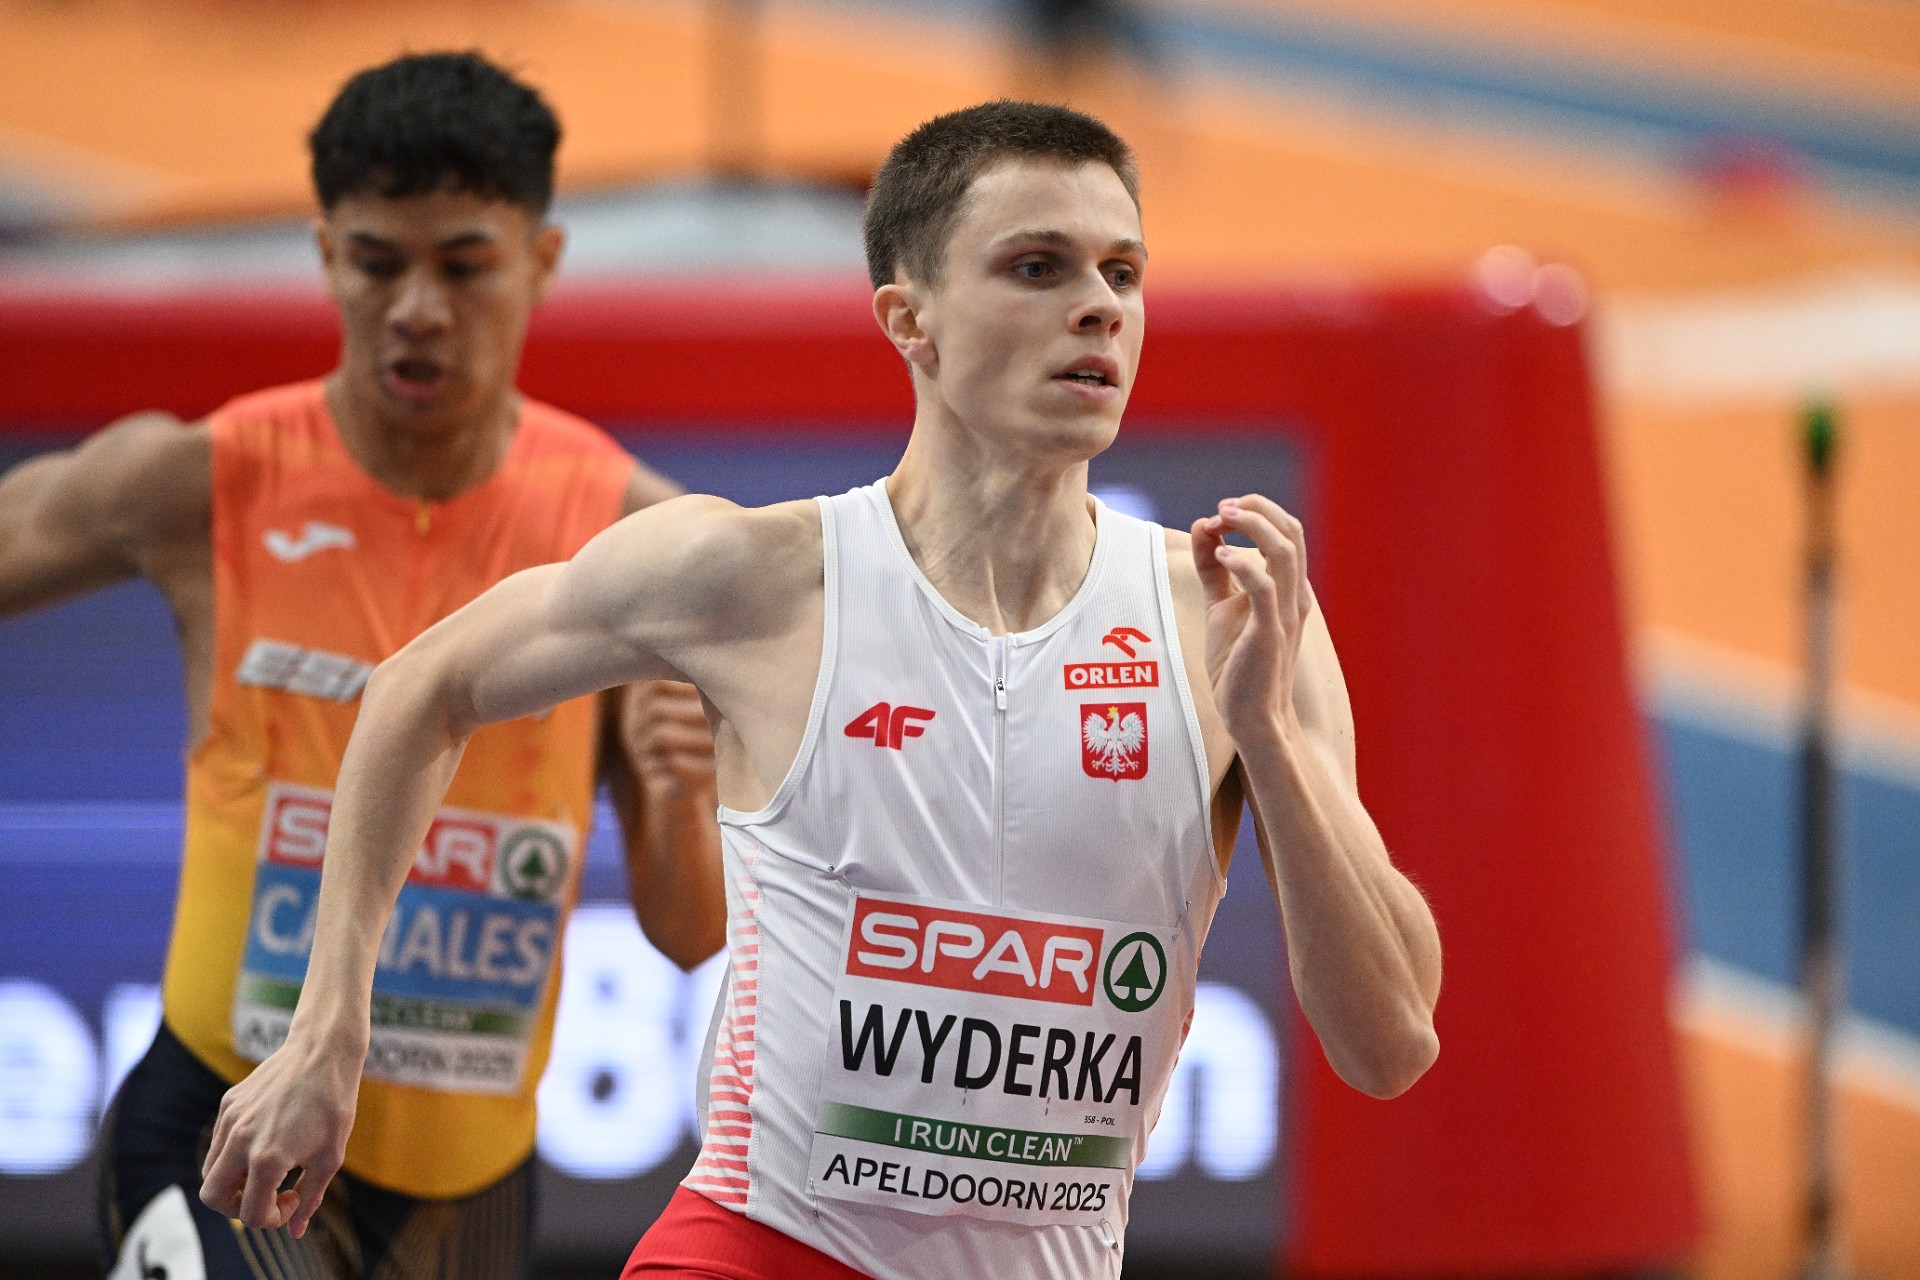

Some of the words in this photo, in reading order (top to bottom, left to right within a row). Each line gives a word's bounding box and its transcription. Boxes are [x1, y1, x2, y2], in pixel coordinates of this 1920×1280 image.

[1069, 665, 1153, 686] ORLEN
[844, 701, 936, 751] 4F
[275, 804, 488, 884] SR
[856, 911, 1093, 994] SPAR
[839, 999, 1142, 1106] WYDERKA
[894, 1118, 902, 1142] I
[910, 1121, 980, 1153] RUN
[1083, 1115, 1096, 1124] 358
[1101, 1116, 1115, 1126] POL
[822, 1153, 1048, 1211] APELDOORN
[1050, 1182, 1111, 1212] 2025
